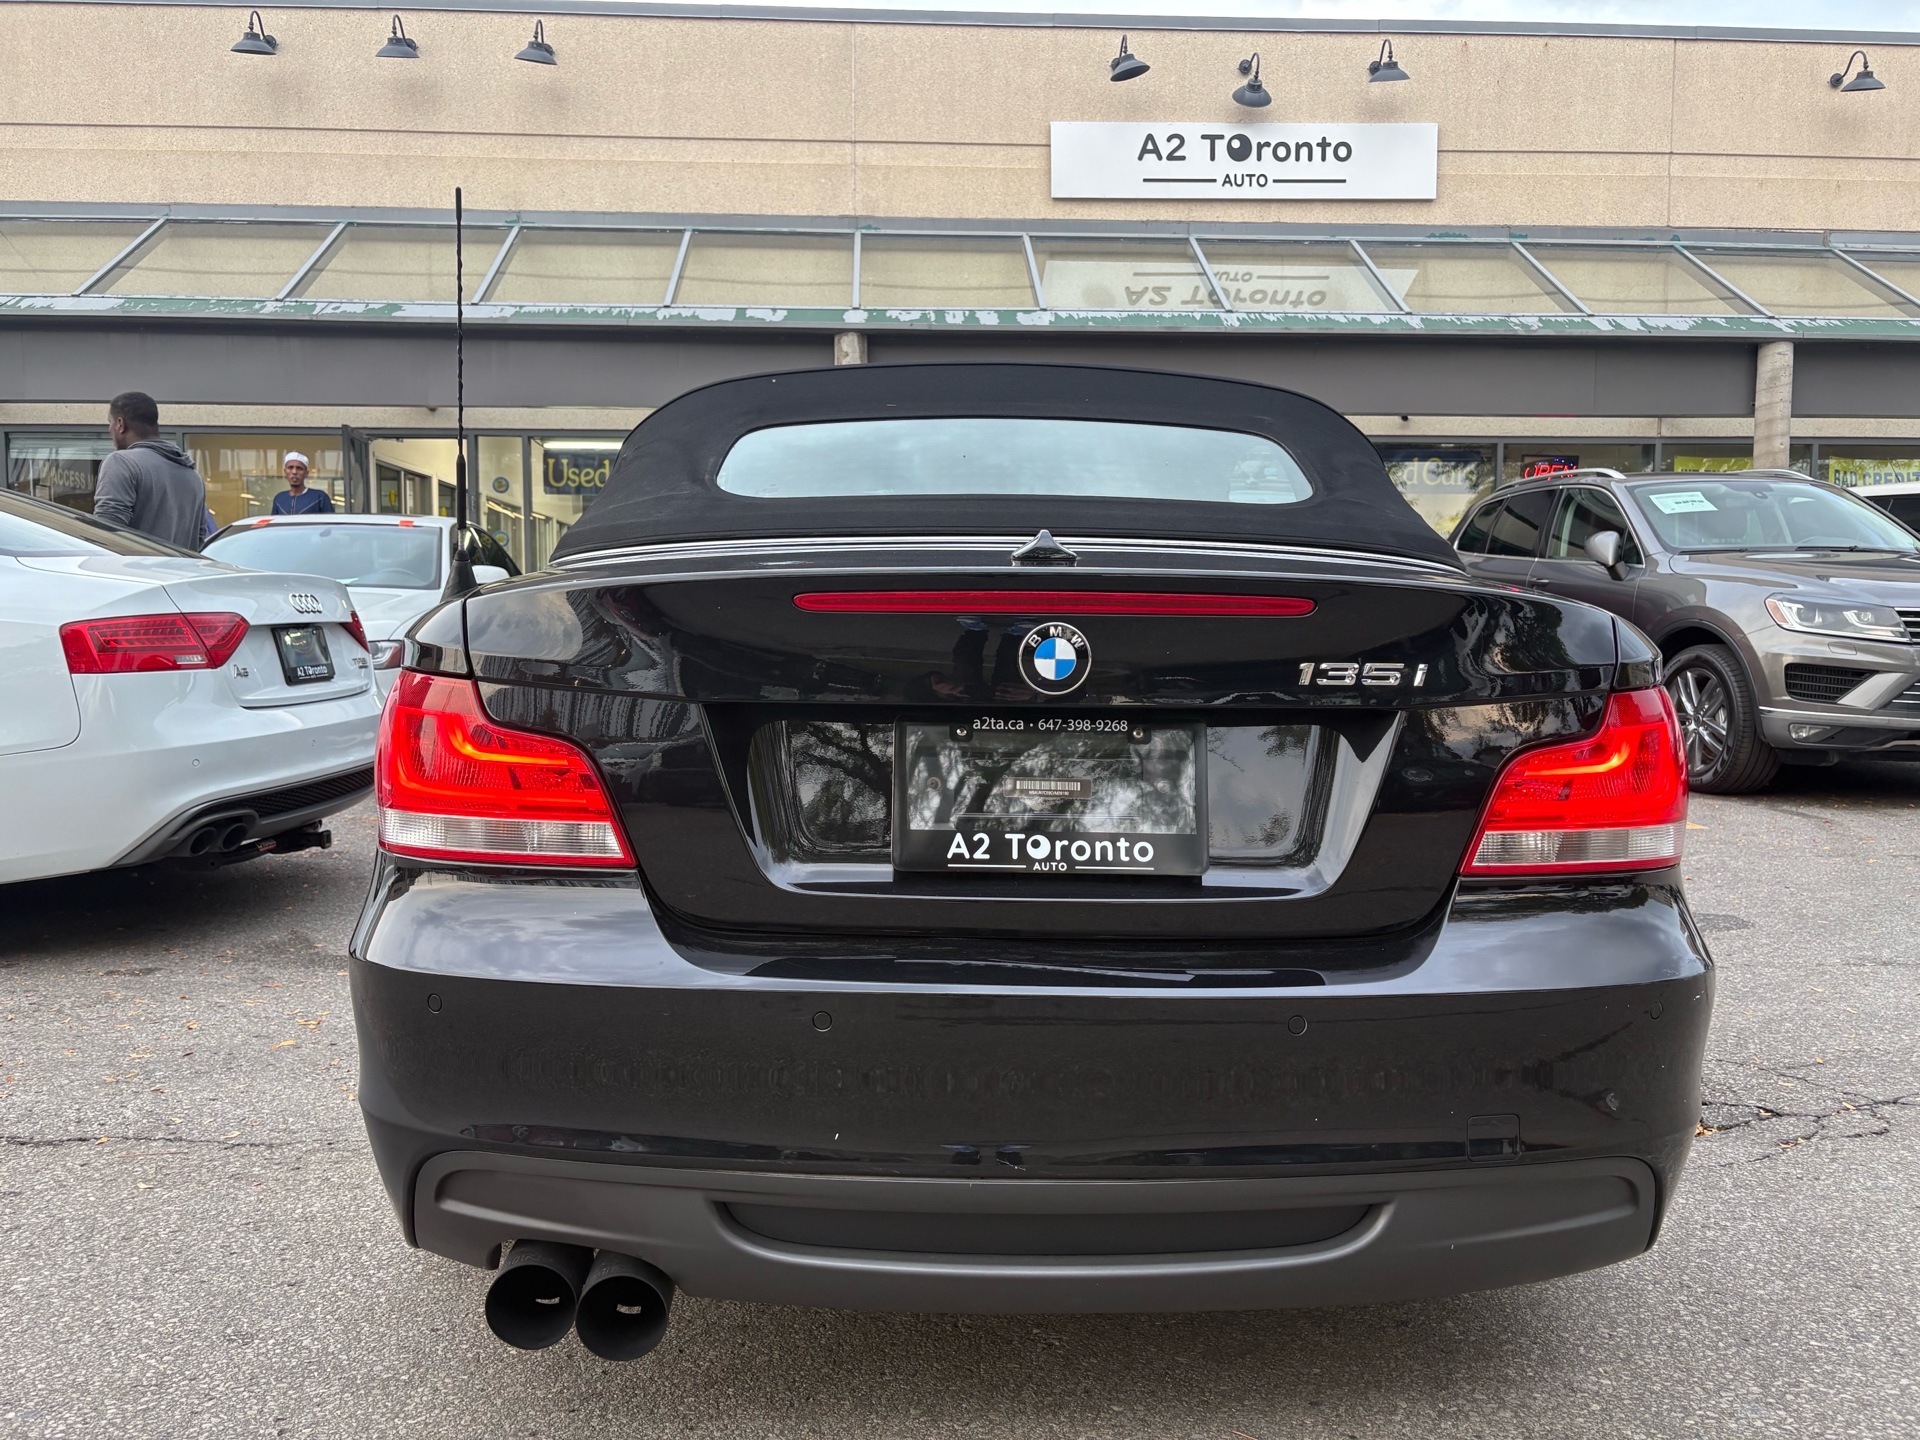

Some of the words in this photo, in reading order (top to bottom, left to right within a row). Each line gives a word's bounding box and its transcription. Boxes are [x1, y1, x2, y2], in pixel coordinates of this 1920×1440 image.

[1137, 133, 1186, 161] A2
[1221, 173, 1268, 187] AUTO
[52, 467, 86, 490] ACCESS
[547, 458, 611, 488] Used
[1422, 457, 1477, 486] Cars
[1834, 469, 1858, 488] BAD
[1028, 626, 1085, 649] BMW
[973, 717, 1024, 730] a2ta.ca
[1038, 718, 1128, 732] 647-398-9268
[946, 832, 991, 860] A2
[1033, 861, 1068, 871] AUTO
